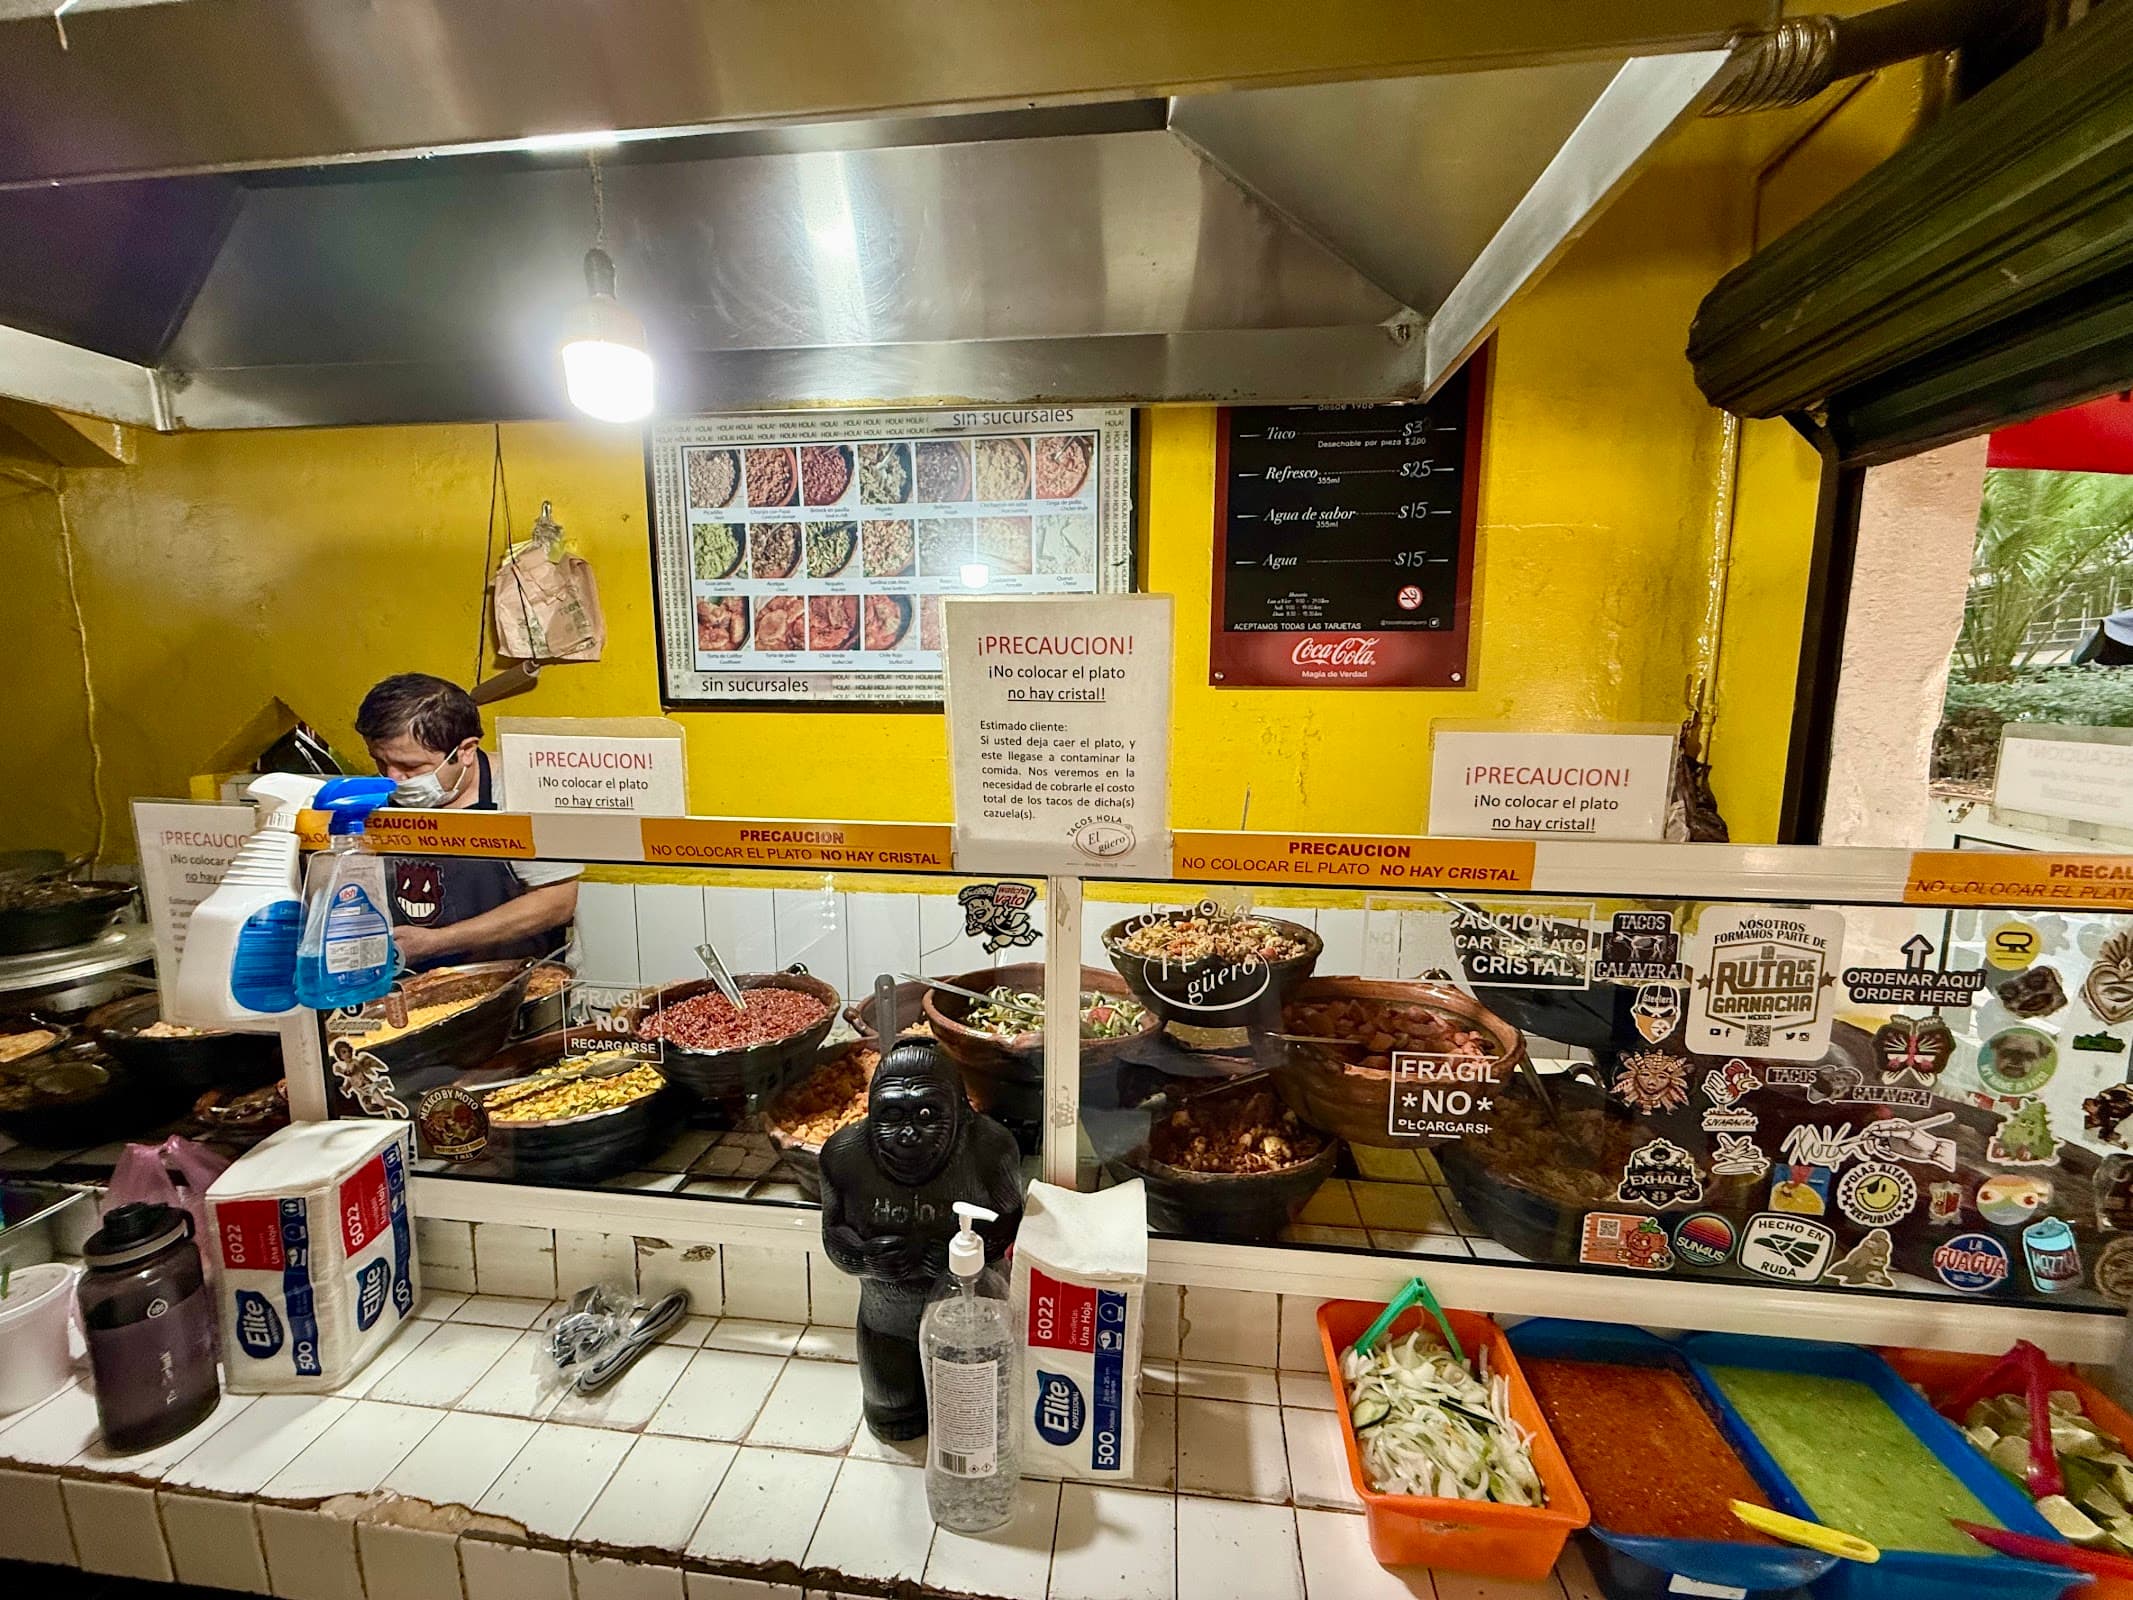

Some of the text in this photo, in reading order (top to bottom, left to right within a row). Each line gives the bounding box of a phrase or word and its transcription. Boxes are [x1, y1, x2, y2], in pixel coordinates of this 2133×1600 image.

[953, 409, 1074, 426] sin sucursales
[1265, 427, 1296, 440] Taco
[1318, 439, 1361, 448] Desechable
[1265, 460, 1434, 483] Refresco $25
[1317, 476, 1340, 484] 355ml
[1264, 502, 1428, 525] Agua de sabor $15
[1263, 551, 1427, 570] Agua $15
[978, 635, 1133, 656] ¡PRECAUCION!
[1292, 637, 1380, 665] Coca-Cola
[989, 665, 1125, 681] ¡No colocar el plato
[1302, 671, 1326, 679] Magia
[702, 677, 808, 692] sin sucursales
[1008, 687, 1106, 702] no hay cristal!
[981, 721, 1068, 732] Estimado cliente:
[981, 736, 1124, 749] Si usted deja caer el plato,
[529, 751, 653, 769] ¡PRECAUCION!
[982, 752, 1135, 763] este llegase contaminar la
[982, 766, 1021, 775] comida.
[1028, 767, 1048, 776] Nos
[1054, 769, 1099, 777] veremos
[1126, 768, 1135, 777] la
[1465, 766, 1630, 787] ¡PRECAUCION!
[538, 776, 648, 791] ¡No colocar el plato
[983, 780, 1135, 792] necesidad de cobrarle el costo
[555, 795, 633, 808] no hay cristal!
[983, 794, 1135, 808] total de los tacos de dicha(s)
[1474, 794, 1619, 812] ¡No colocar el plato
[983, 809, 1036, 820] cazuela(s).
[1066, 814, 1122, 838] TACOS HOLA
[1492, 816, 1596, 831] no hay cristal!
[370, 832, 526, 849] PLATO NO HAY CRISTAL
[740, 830, 844, 844] PRECAUCION
[652, 845, 940, 865] NO COLOCAR EL PLATO NO HAY CRISTAL
[1289, 842, 1410, 858] PRECAUCION
[190, 855, 225, 866] colocar
[1182, 857, 1520, 881] NO COLOCAR EL PLATO NO HAY CRISTAL
[1915, 880, 2073, 898] NO COLOCAR EL
[995, 894, 1025, 906] vato
[1619, 915, 1666, 930] TACOS
[1739, 919, 1807, 932] NOSOTROS
[1528, 938, 1586, 953] PLATO
[1714, 929, 1828, 949] FORMAMOS PARTE DE
[1472, 955, 1574, 977] CRISTAL
[1597, 961, 1680, 979] CALAVERA
[1715, 959, 1816, 995] RUTA DE
[1795, 973, 1814, 986] LA
[1847, 971, 1982, 988] ORDENAR AQUÍ
[577, 989, 650, 1009] FRAGIL
[1712, 995, 1812, 1013] GARNACHA
[1854, 987, 1968, 1004] ORDER HERE
[570, 1038, 656, 1054] RECARGARSE
[1400, 1059, 1500, 1083] FRAGIL
[1772, 1069, 1929, 1105] TACOS CALAVERA
[1630, 1174, 1690, 1186] EXHALE
[1879, 1164, 1910, 1185] ALTAS
[347, 1202, 365, 1246] 6022
[1850, 1208, 1901, 1223] REPUBLIC
[1758, 1220, 1826, 1242] HECHO EN
[227, 1224, 246, 1264] 6022
[1677, 1236, 1725, 1262] SUN4US
[1761, 1261, 1797, 1277] RUDA
[1933, 1245, 2008, 1279] GUAGUA
[363, 1265, 382, 1321] Elite
[243, 1300, 272, 1347] Elite
[1037, 1296, 1054, 1340] 6022
[1080, 1302, 1092, 1346] Una Hoja
[297, 1341, 316, 1370] 500
[1043, 1381, 1070, 1433] Elite
[1098, 1431, 1115, 1465] 500
